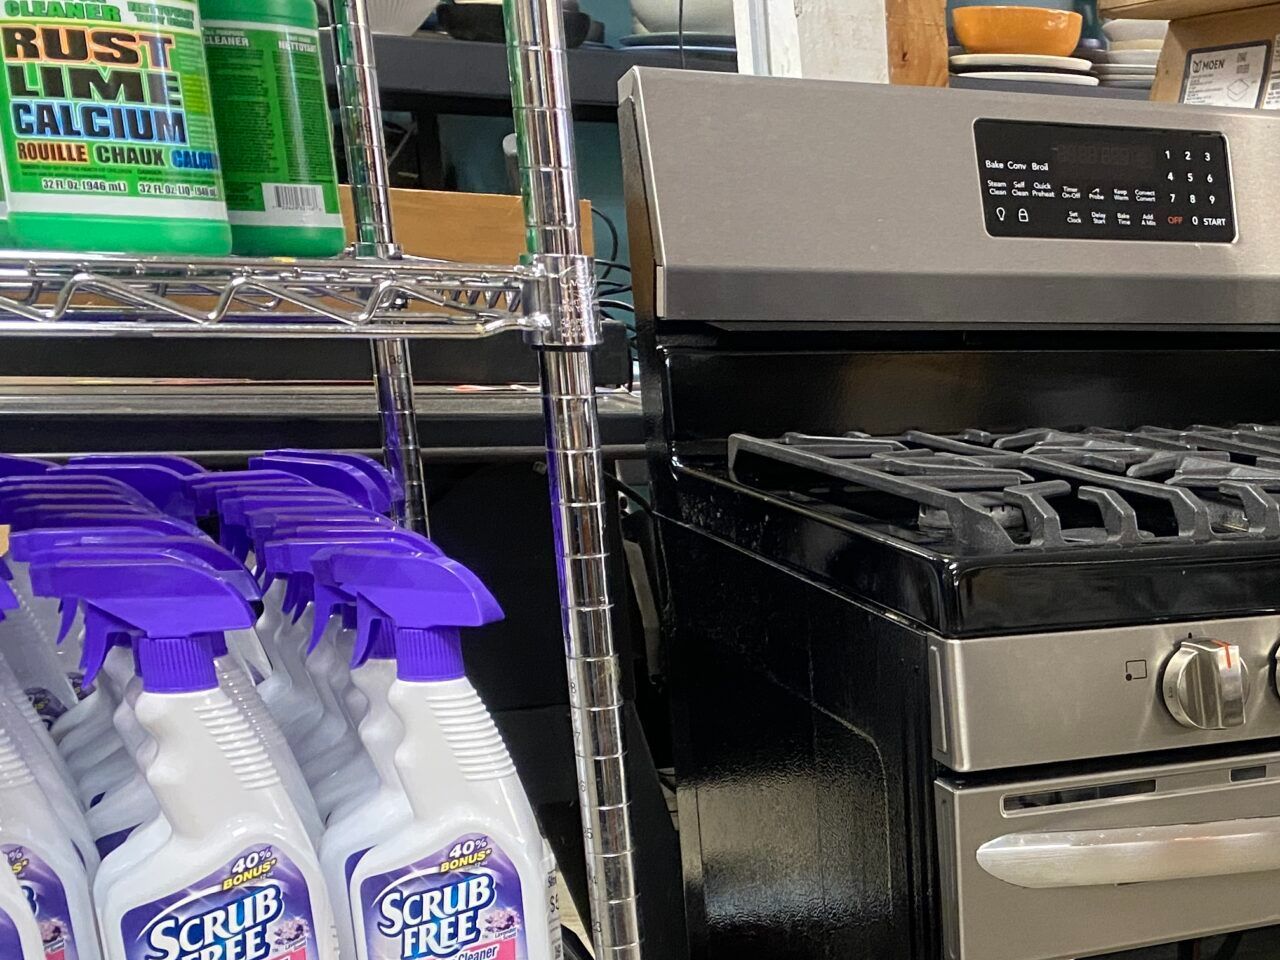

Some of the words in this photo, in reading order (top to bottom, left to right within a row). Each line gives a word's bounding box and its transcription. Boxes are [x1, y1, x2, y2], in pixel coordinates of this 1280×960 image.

[5, 0, 121, 22] CLEANER
[3, 26, 174, 70] RUST
[8, 65, 182, 107] LIME
[14, 102, 187, 144] CALCIUM
[17, 142, 87, 163] ROUILLE
[95, 145, 166, 167] CHAUX
[1165, 150, 1170, 160] 1
[1184, 151, 1191, 161] 2
[1204, 152, 1211, 162] 3
[985, 160, 1004, 169] Bake
[1007, 161, 1027, 170] Conv
[1031, 162, 1049, 171] Broil
[43, 179, 55, 189] 32
[1167, 172, 1174, 181] 4
[1187, 172, 1194, 182] 5
[1207, 174, 1213, 183] 6
[139, 184, 152, 193] 32
[1169, 193, 1176, 203] 7
[1189, 194, 1196, 204] 8
[1209, 195, 1216, 205] 9
[1167, 216, 1184, 225] OFF
[1192, 216, 1199, 226] 0
[1203, 217, 1226, 226] START
[449, 838, 488, 859] 40%
[231, 849, 273, 874] 40%
[378, 875, 491, 935] SCRUB
[402, 911, 477, 958] FREE
